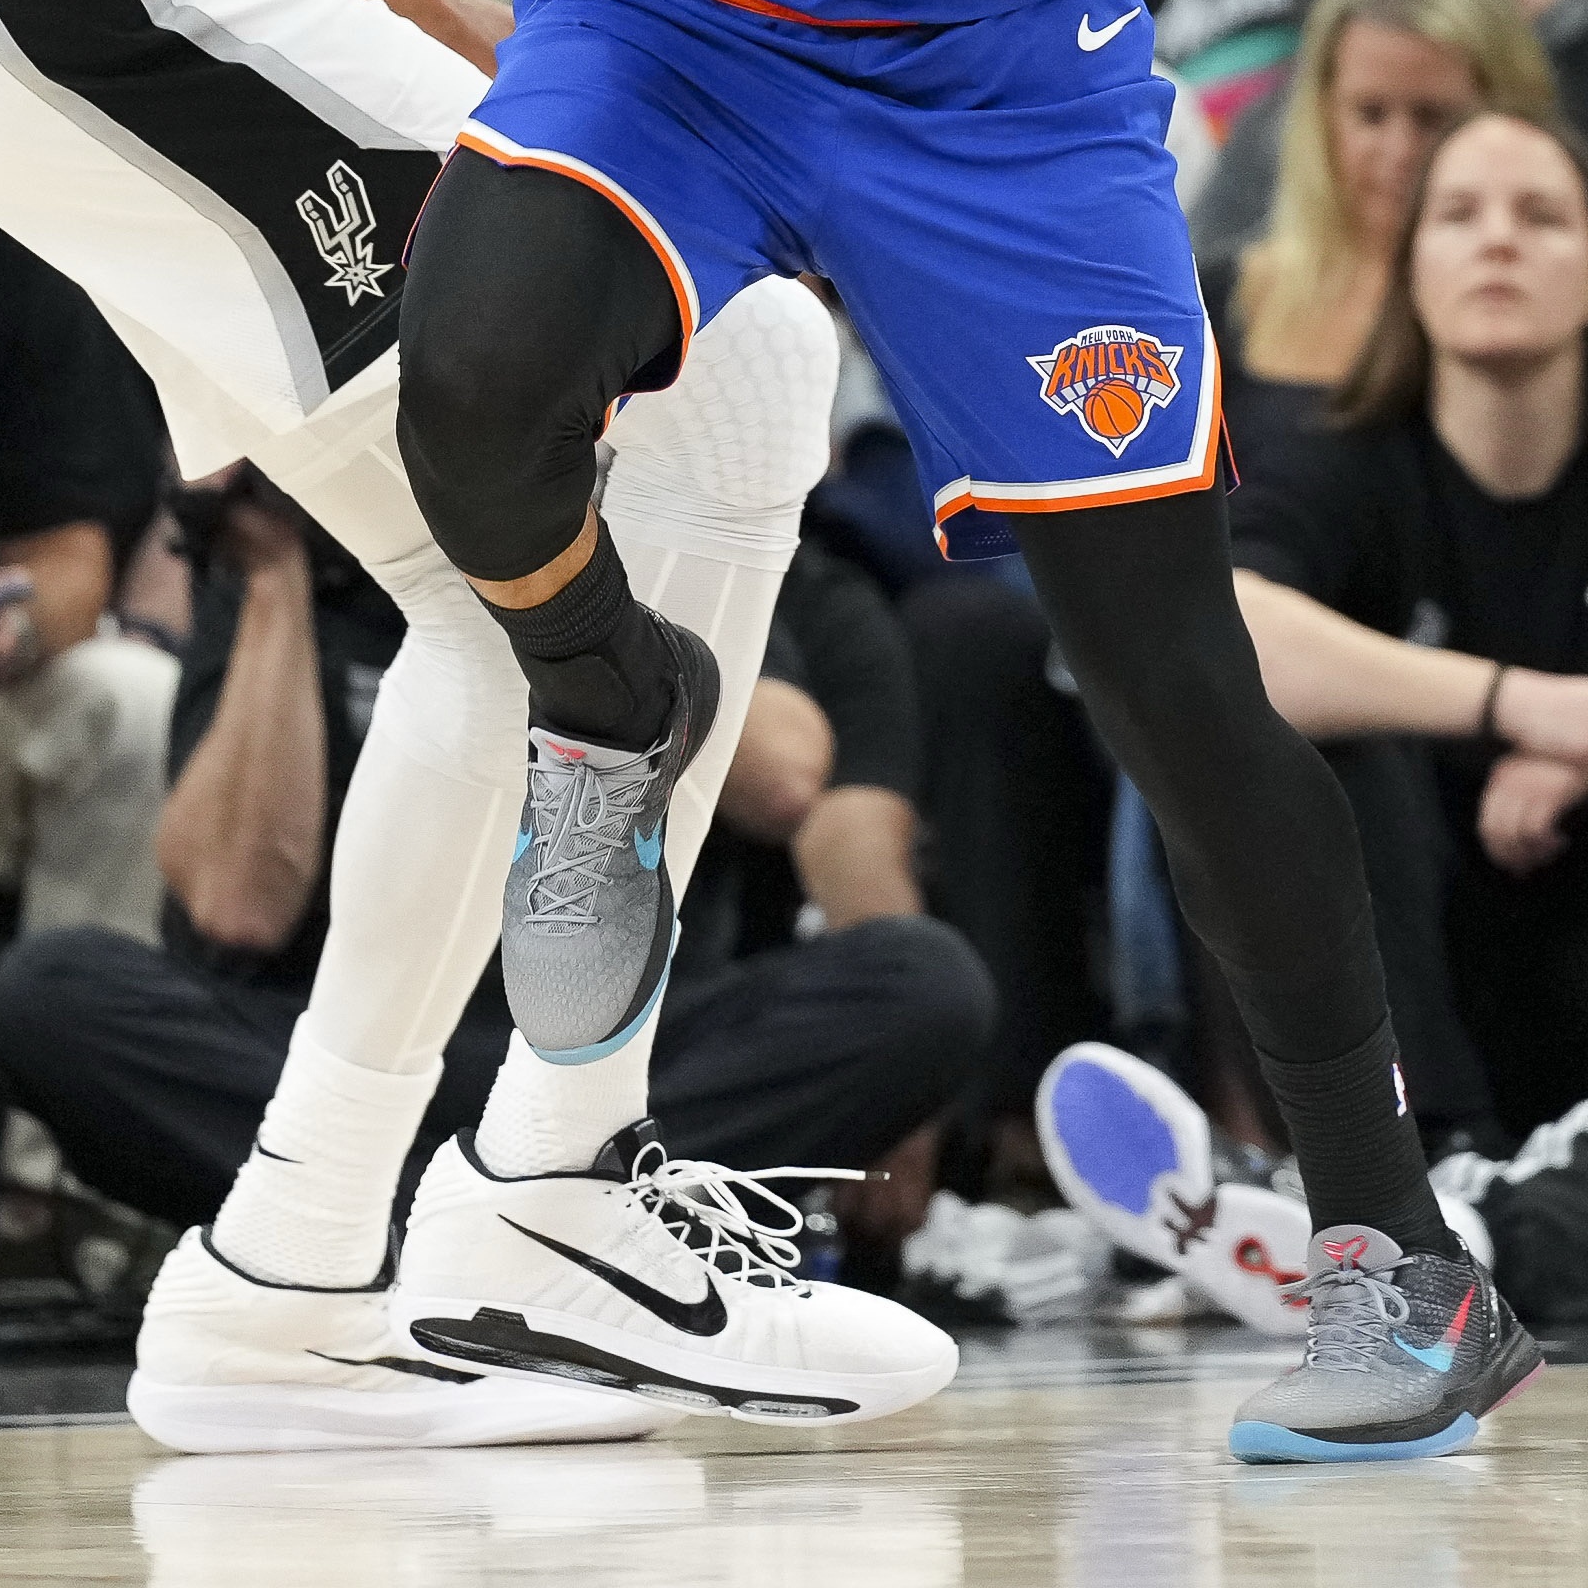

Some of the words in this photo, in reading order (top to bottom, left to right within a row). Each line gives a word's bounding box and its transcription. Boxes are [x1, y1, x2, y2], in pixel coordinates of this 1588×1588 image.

[1080, 330, 1103, 346] NEW
[1105, 329, 1134, 342] YORK
[1045, 338, 1175, 398] KNICKS
